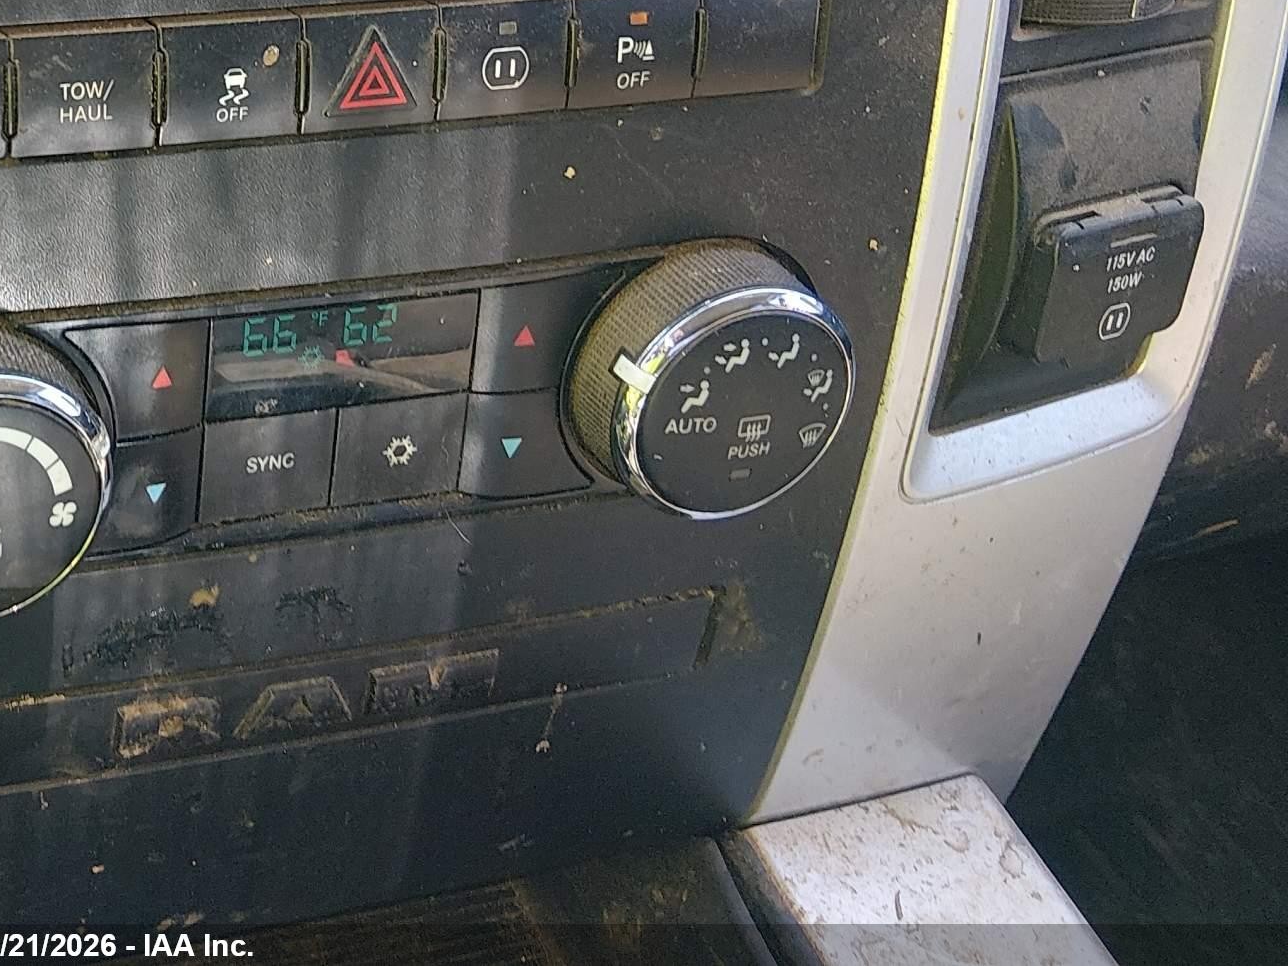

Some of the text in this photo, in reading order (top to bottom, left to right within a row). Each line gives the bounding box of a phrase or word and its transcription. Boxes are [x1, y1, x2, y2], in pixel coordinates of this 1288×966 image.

[59, 79, 114, 101] TOW/
[617, 70, 651, 90] OFF
[60, 103, 113, 124] HAUL
[216, 106, 249, 123] OFF
[1107, 271, 1143, 294] 150W
[243, 313, 297, 357] 66
[343, 303, 398, 347] 62
[664, 417, 717, 434] AUTO
[727, 441, 770, 460] PUSH
[246, 452, 295, 474] SYNC
